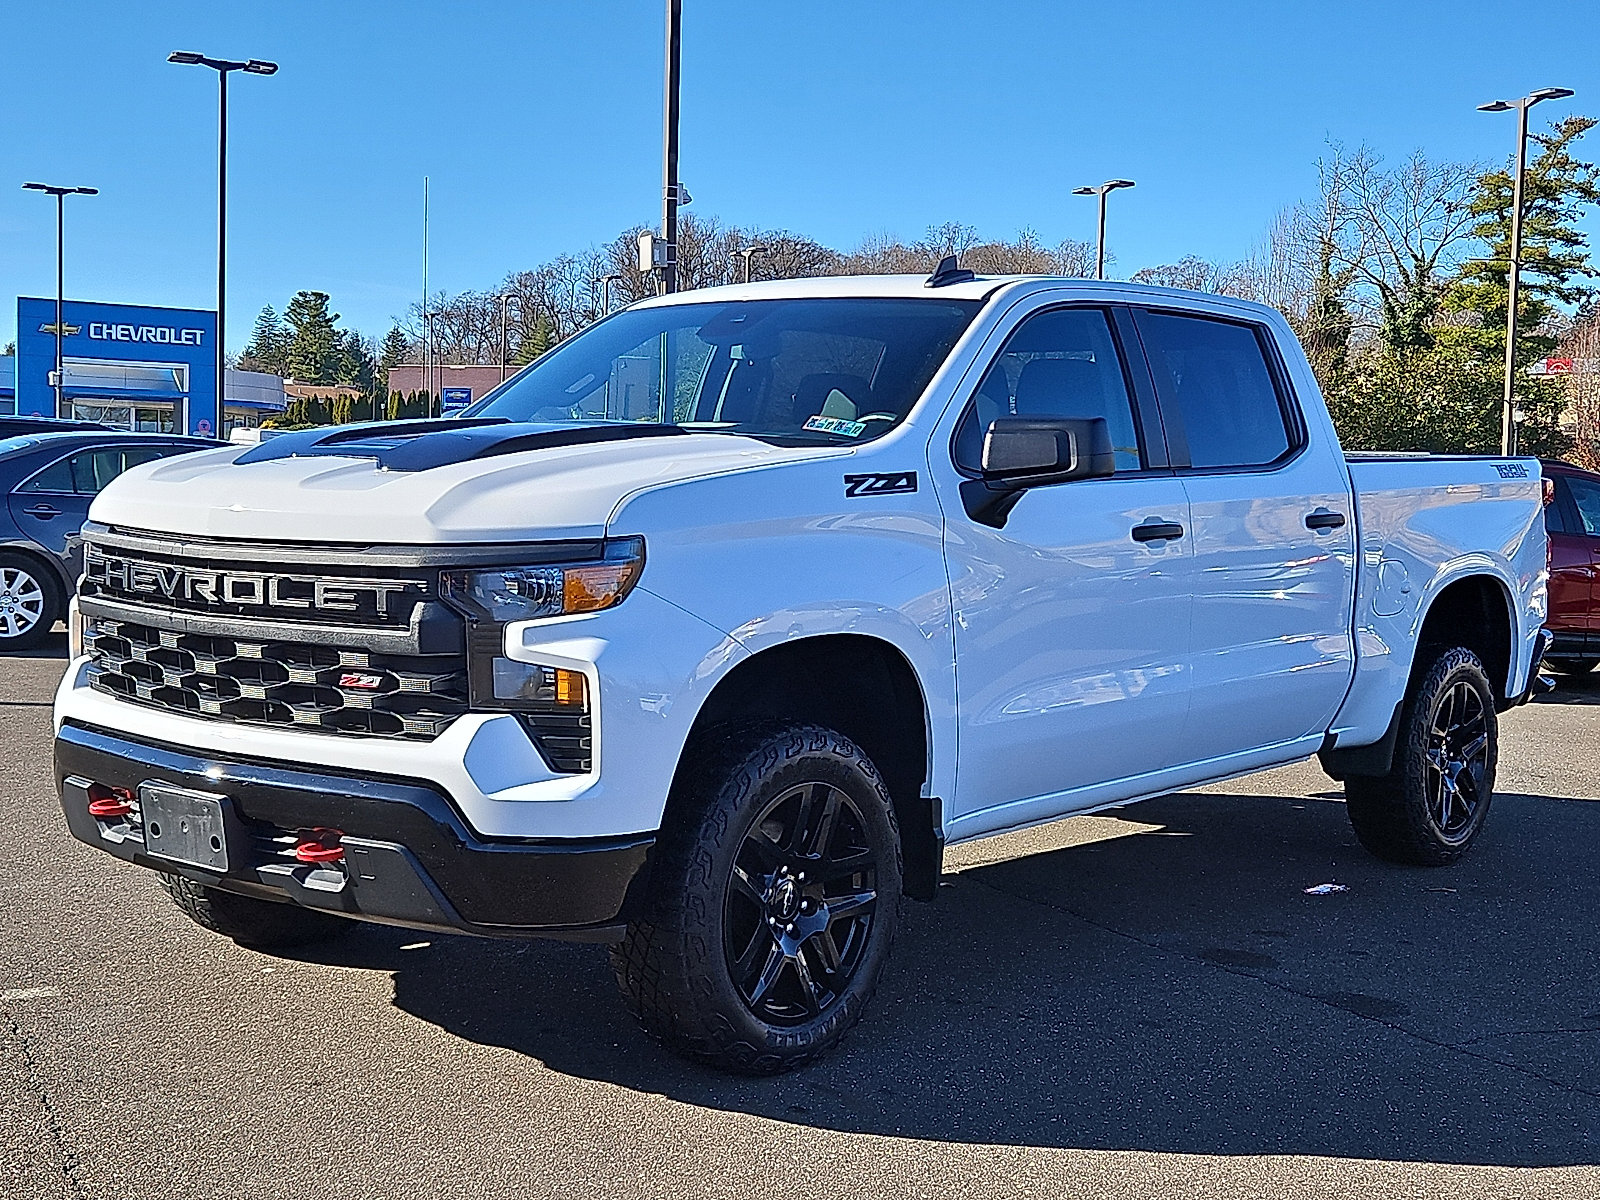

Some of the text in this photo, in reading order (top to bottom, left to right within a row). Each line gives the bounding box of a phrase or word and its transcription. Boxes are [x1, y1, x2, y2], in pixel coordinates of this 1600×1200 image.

[89, 322, 205, 346] CHEVROLET
[1489, 463, 1530, 473] TRAIL
[844, 470, 918, 498] Z71
[84, 553, 405, 616] CHEVROLET
[339, 672, 383, 688] Z71
